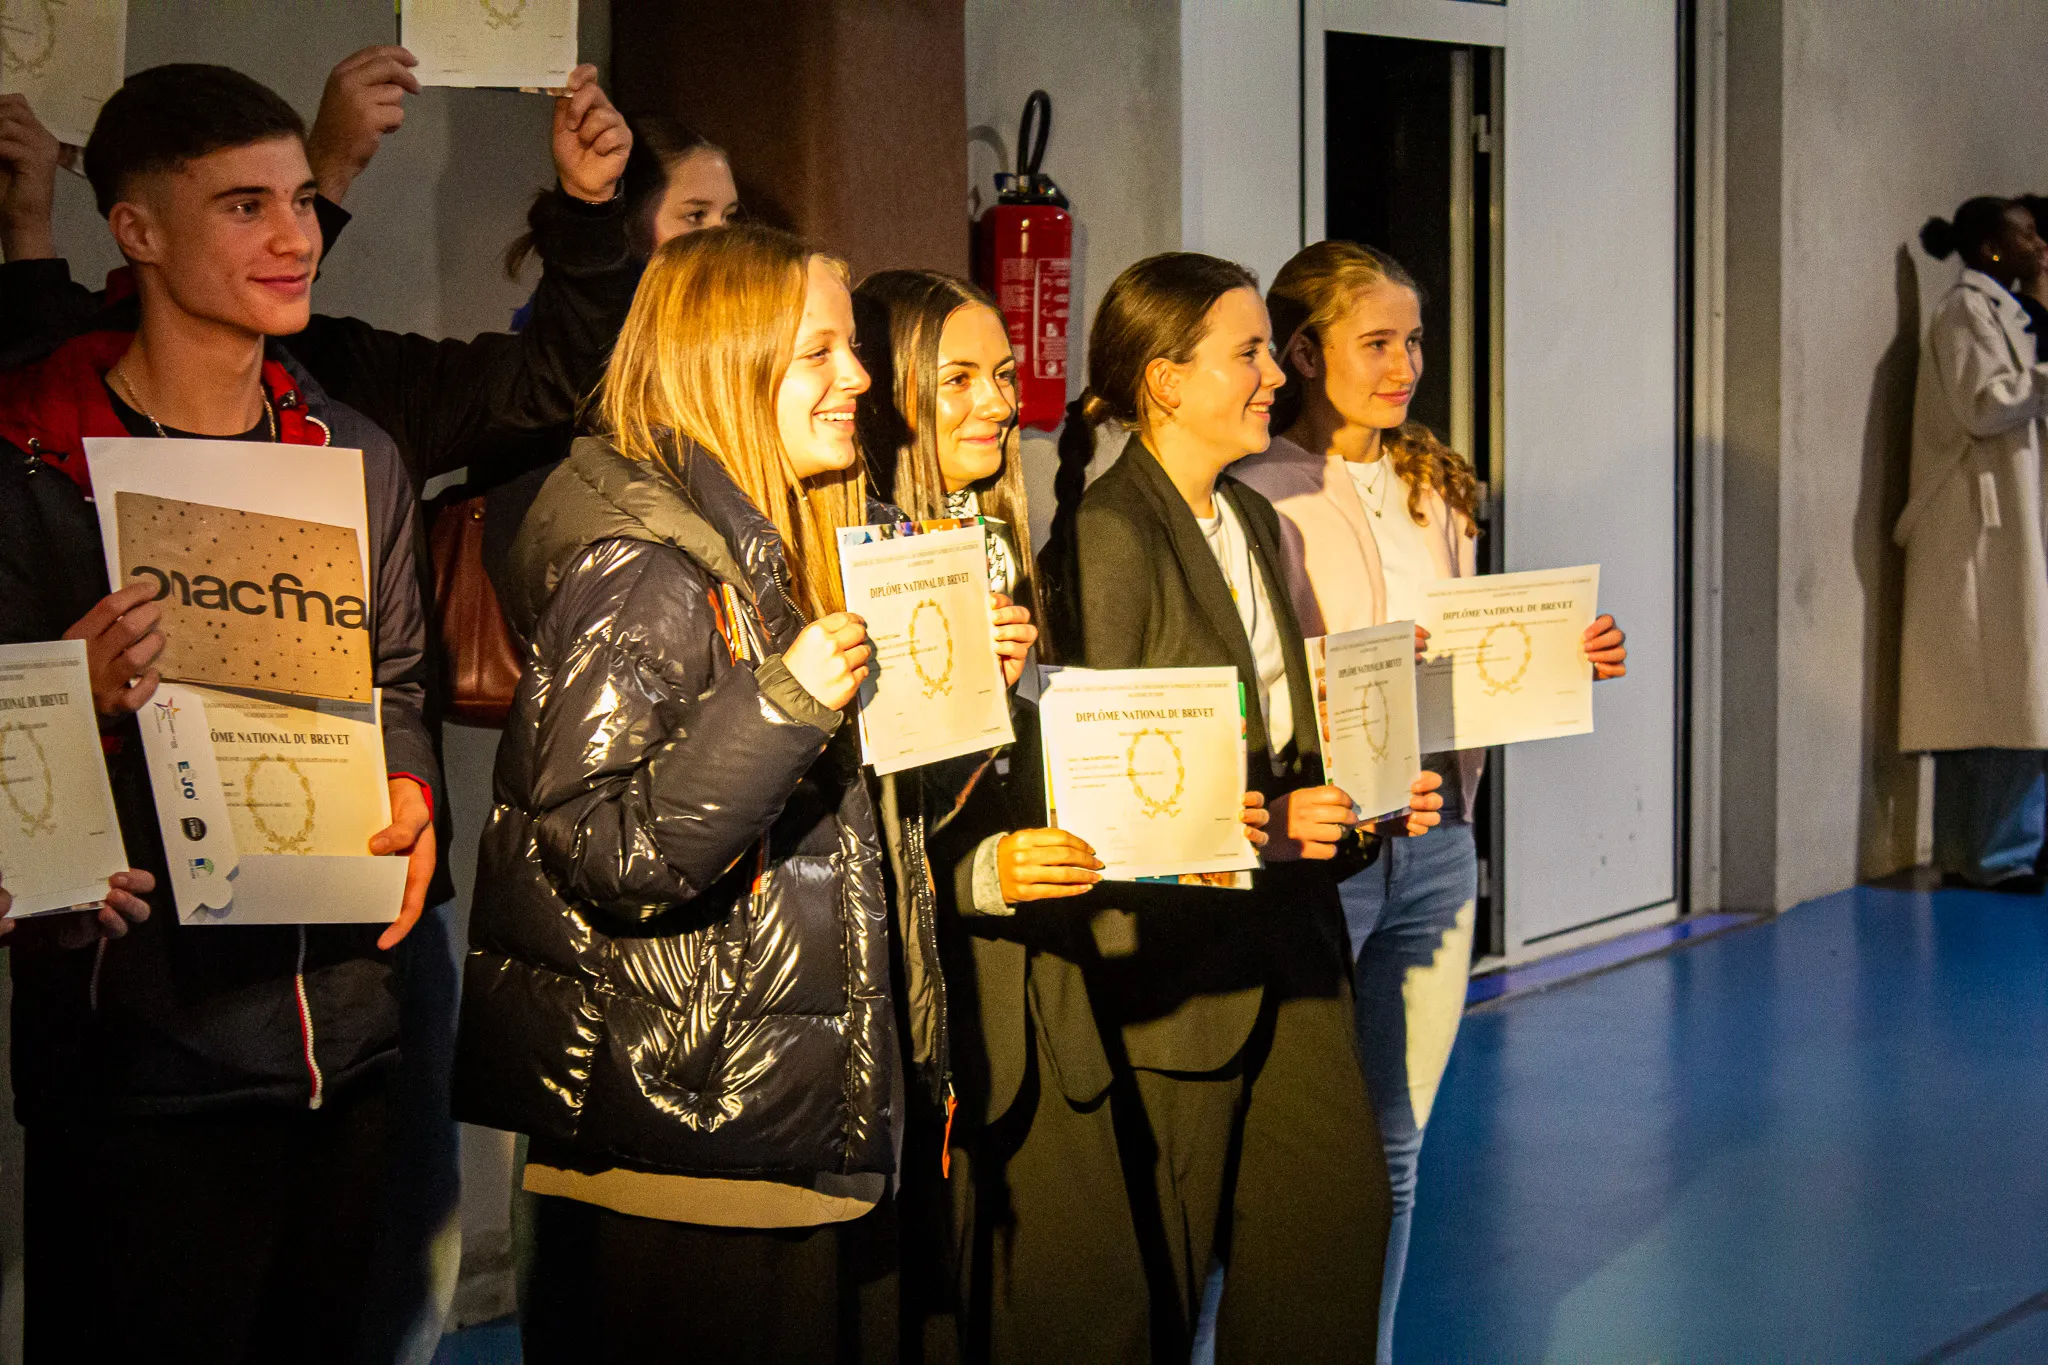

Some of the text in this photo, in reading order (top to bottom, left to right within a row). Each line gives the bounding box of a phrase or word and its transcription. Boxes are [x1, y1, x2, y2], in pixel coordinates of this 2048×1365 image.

[870, 572, 969, 599] DIPLÔME NATIONAL DU BREVET
[1443, 600, 1573, 621] DIPLÔME NATIONAL DU BREVET
[40, 692, 69, 707] BREVET
[1076, 707, 1215, 723] DIPLÔME NATIONAL DU BREVET
[211, 728, 350, 746] ÔME NATIONAL DU BREVET
